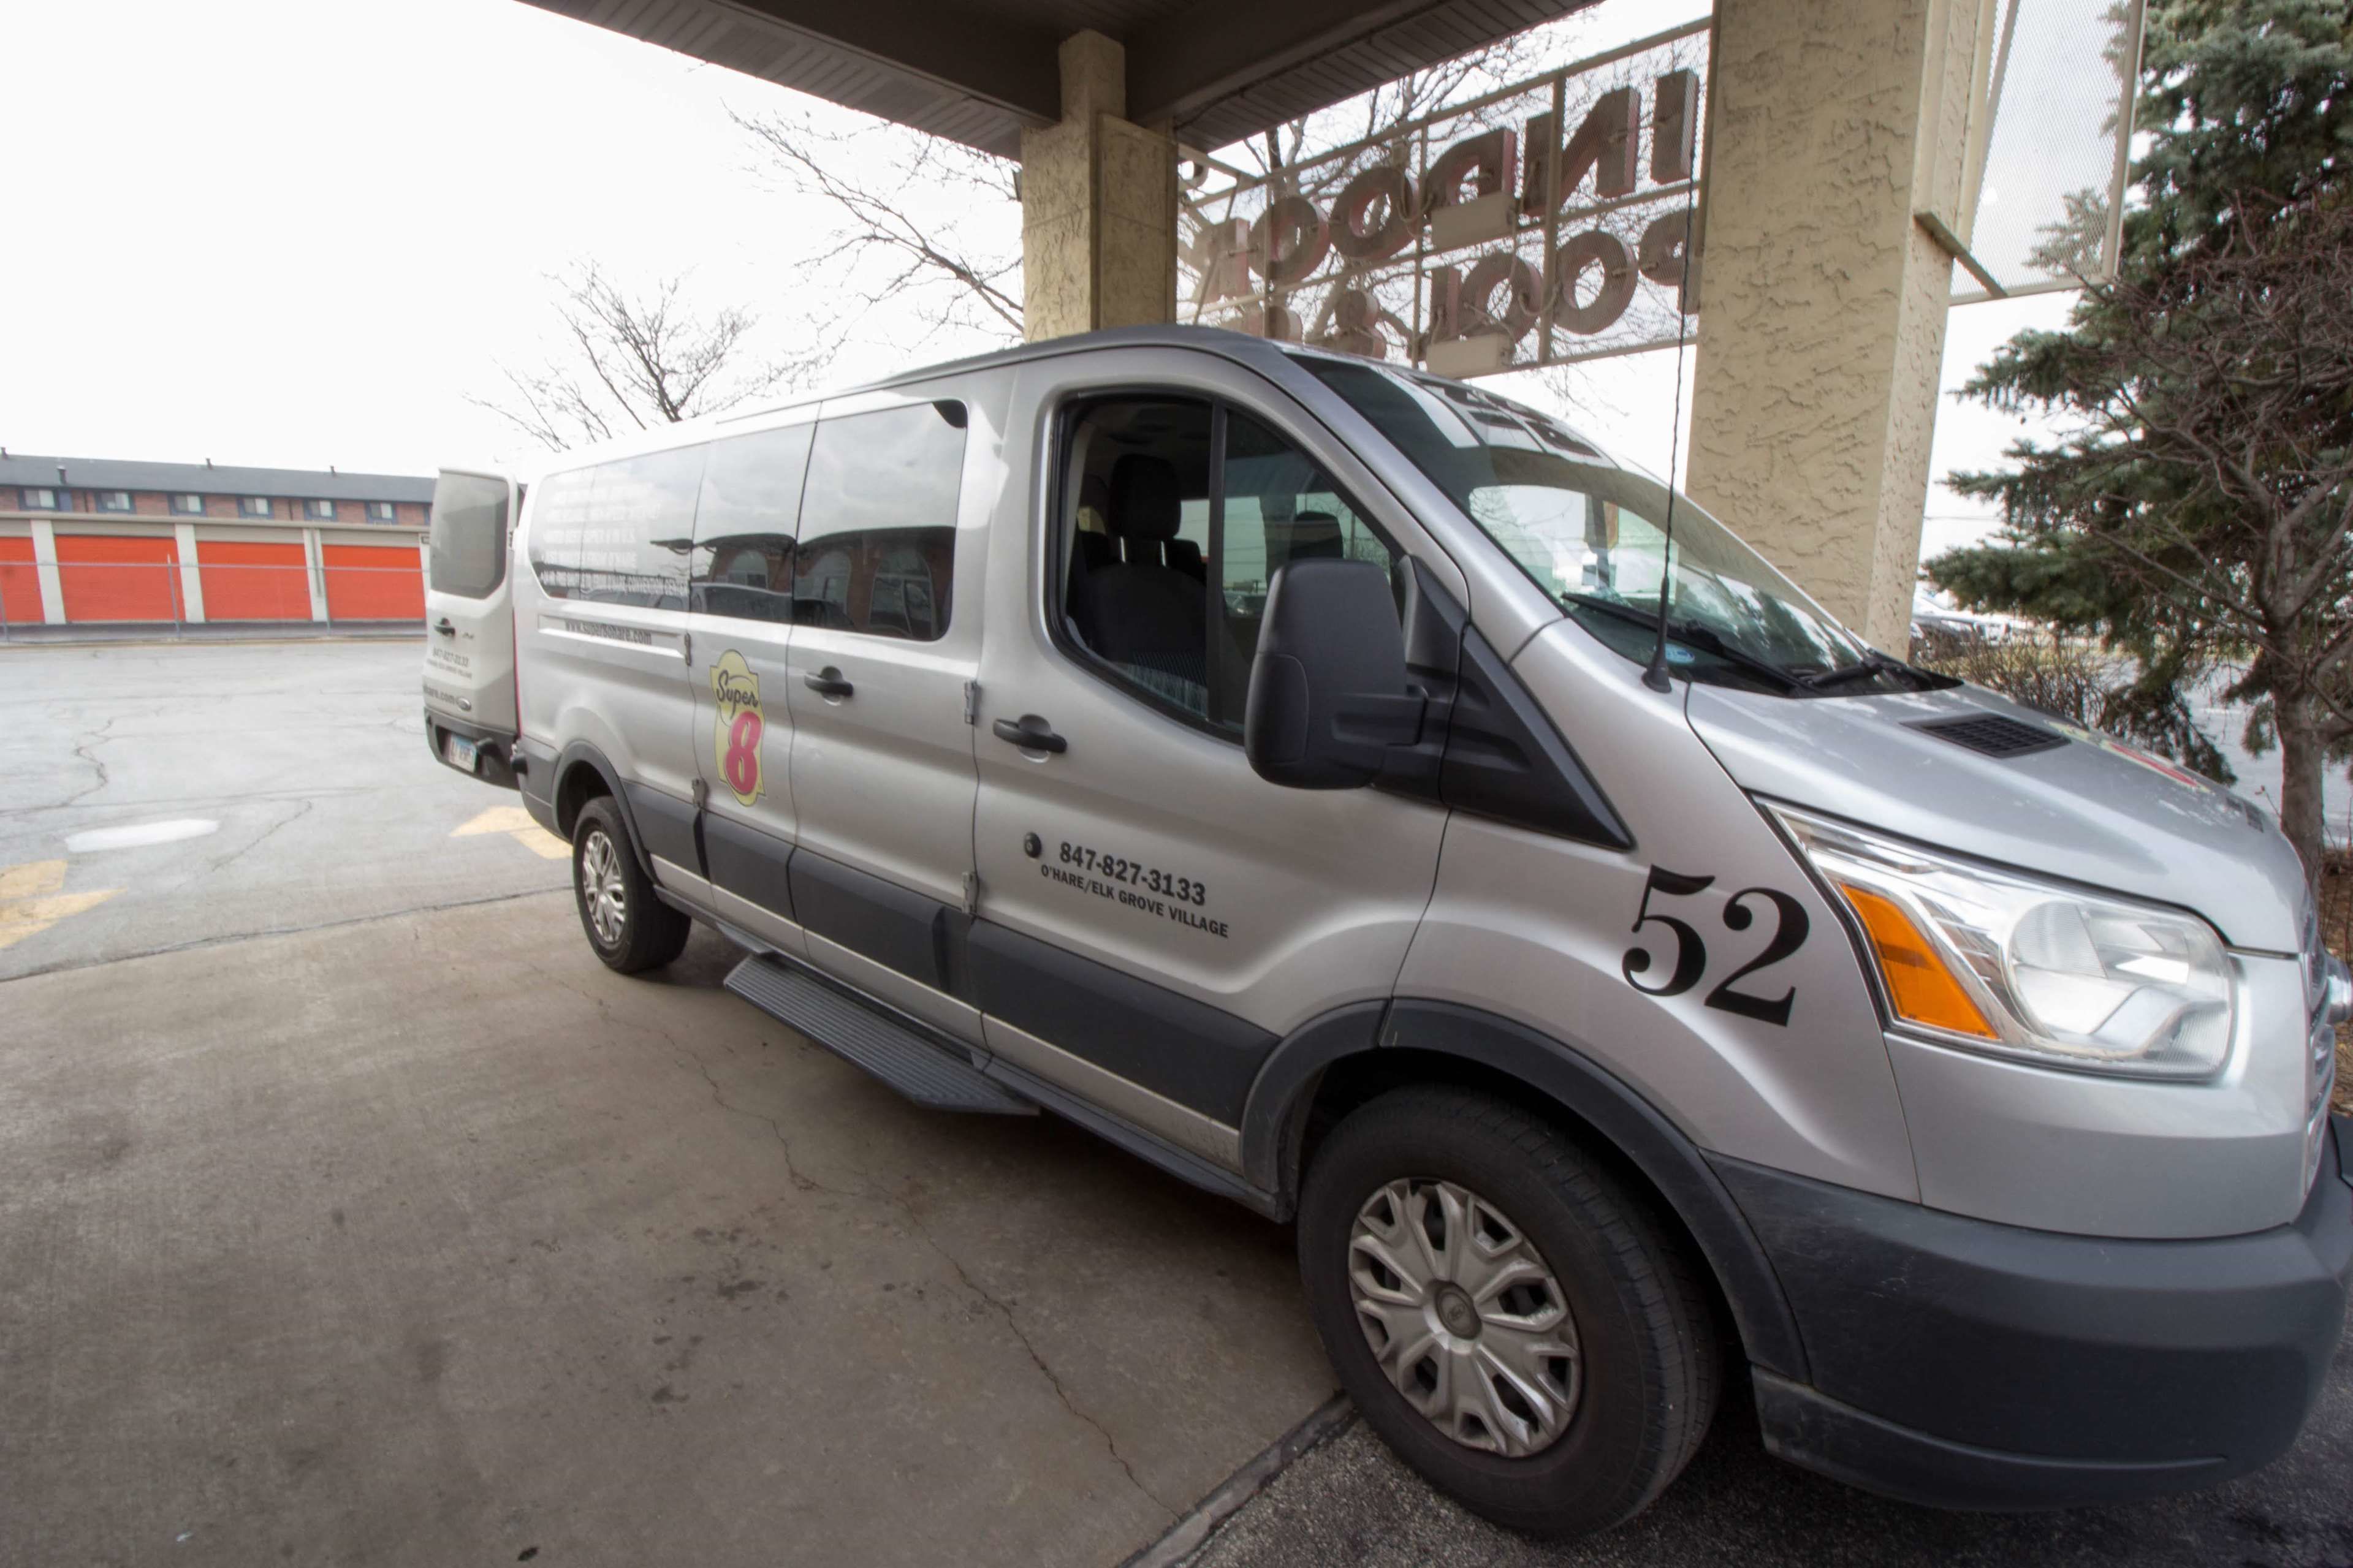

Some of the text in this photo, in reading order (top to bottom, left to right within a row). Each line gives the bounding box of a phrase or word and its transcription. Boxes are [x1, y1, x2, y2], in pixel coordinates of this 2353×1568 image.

[716, 669, 759, 721] Super
[724, 710, 762, 795] 8
[1041, 864, 1229, 938] O'HARE/ELK GROVE VILLAGE
[1060, 841, 1206, 906] 847-827-3133
[1622, 863, 1811, 1028] 52
